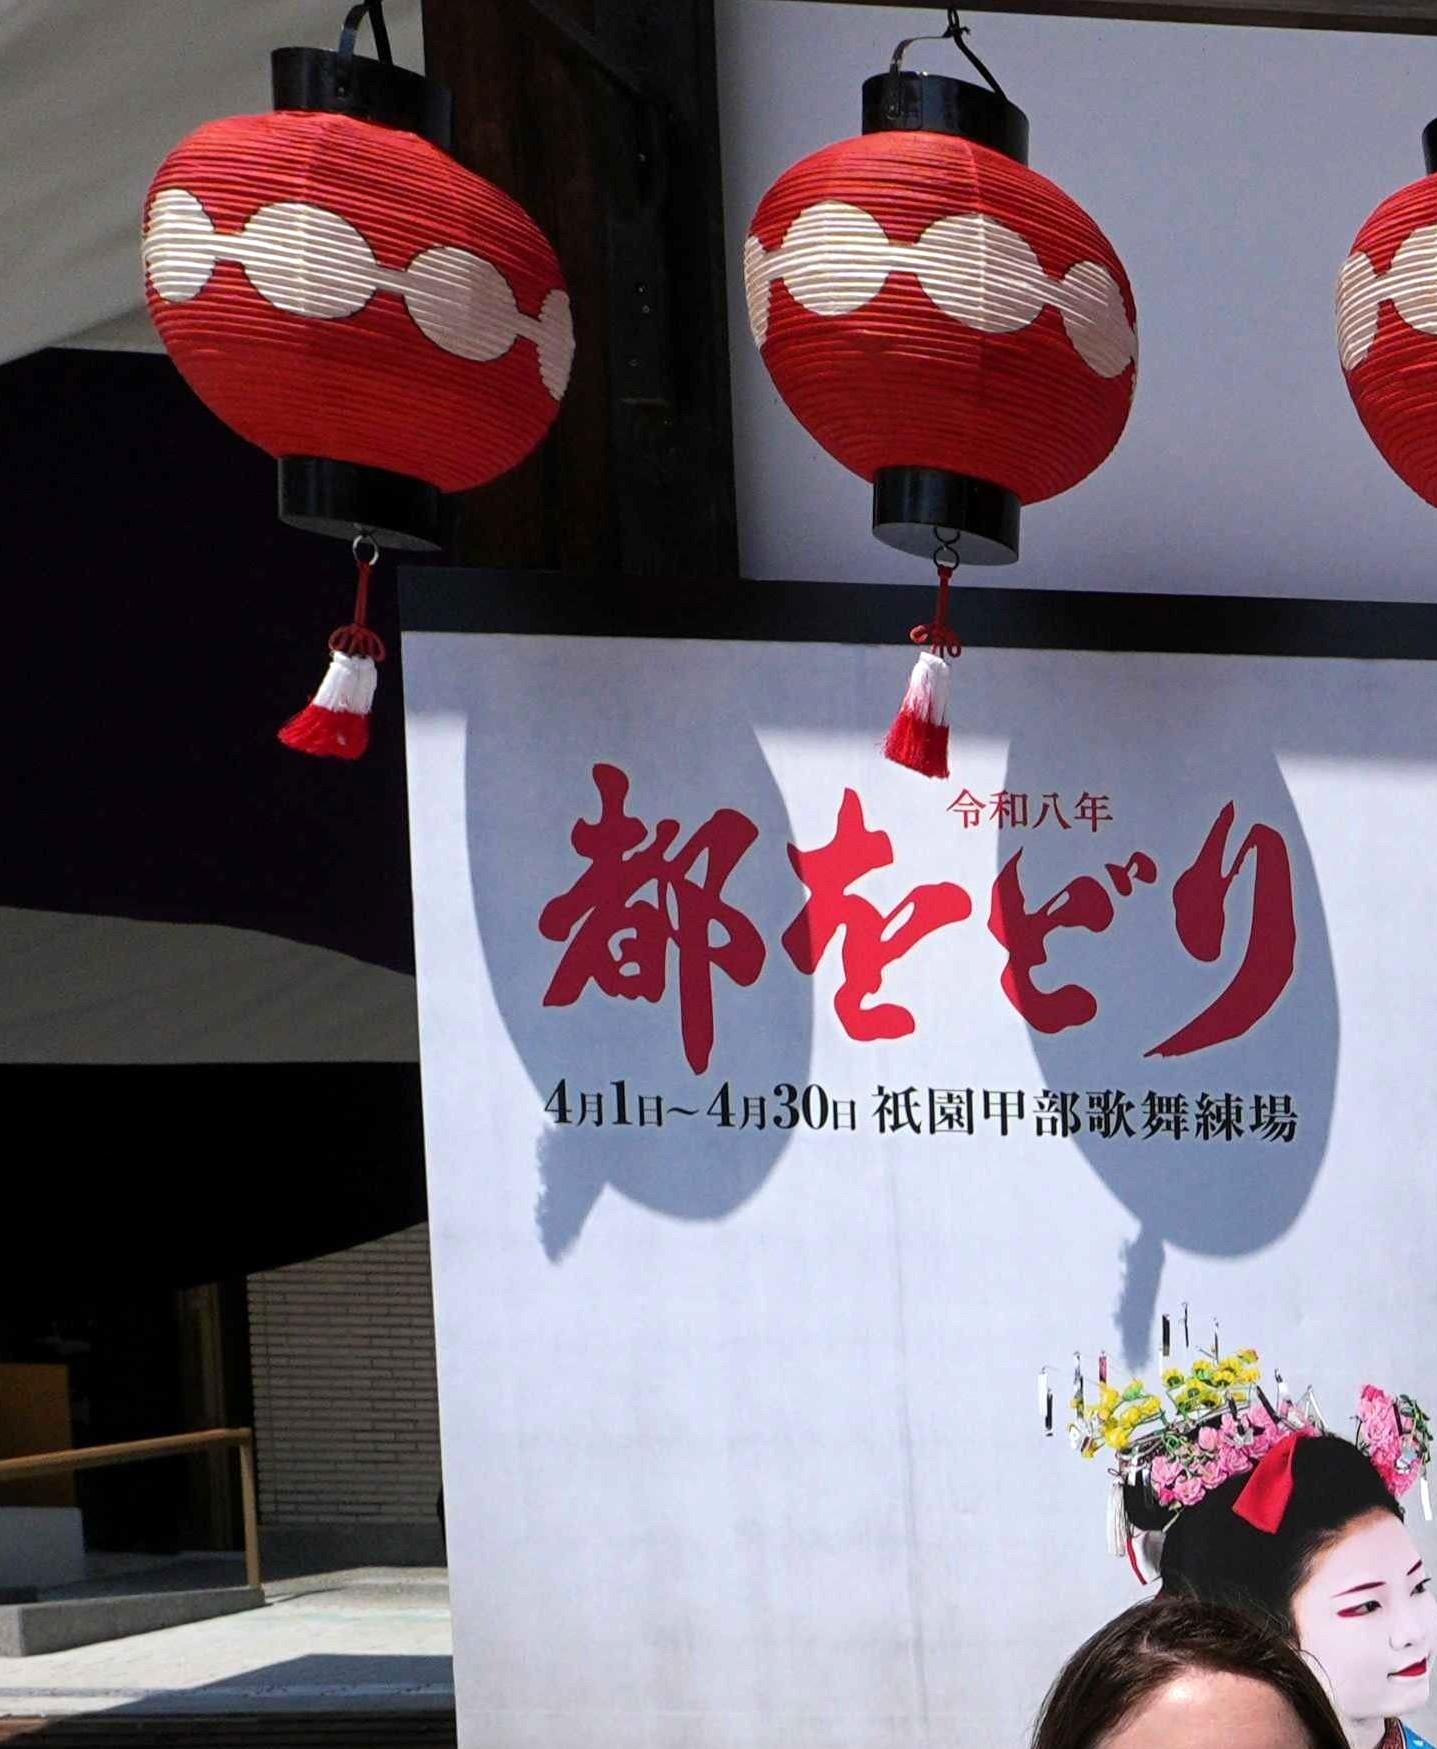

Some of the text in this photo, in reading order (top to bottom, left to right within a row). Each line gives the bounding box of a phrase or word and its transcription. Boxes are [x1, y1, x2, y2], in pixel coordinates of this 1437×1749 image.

[946, 788, 1113, 833] 令和八年
[538, 762, 1298, 1076] 都をどり
[871, 1085, 1299, 1143] 祇園甲部歌舞練場
